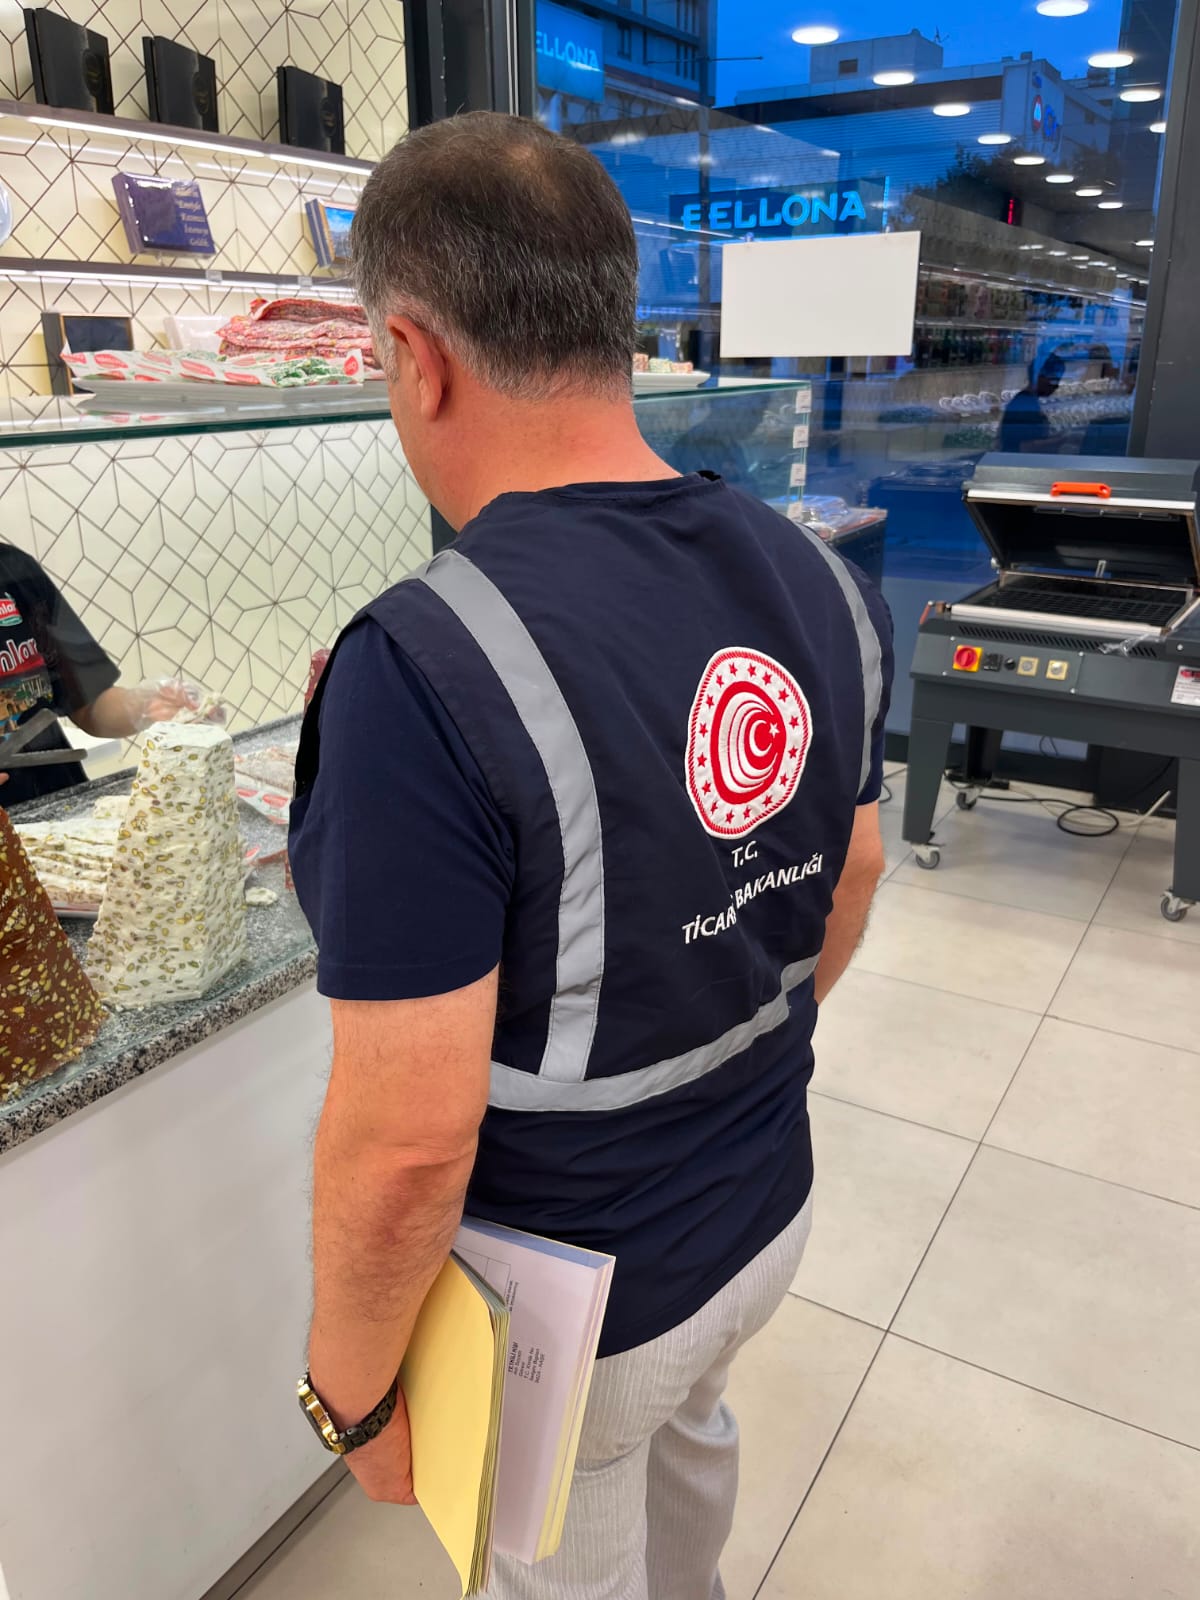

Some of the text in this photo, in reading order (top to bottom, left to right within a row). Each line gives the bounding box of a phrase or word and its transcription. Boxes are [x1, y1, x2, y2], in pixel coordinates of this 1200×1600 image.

[731, 840, 758, 868] T.C.
[682, 852, 823, 945] TİCAR BAKANLIĞI
